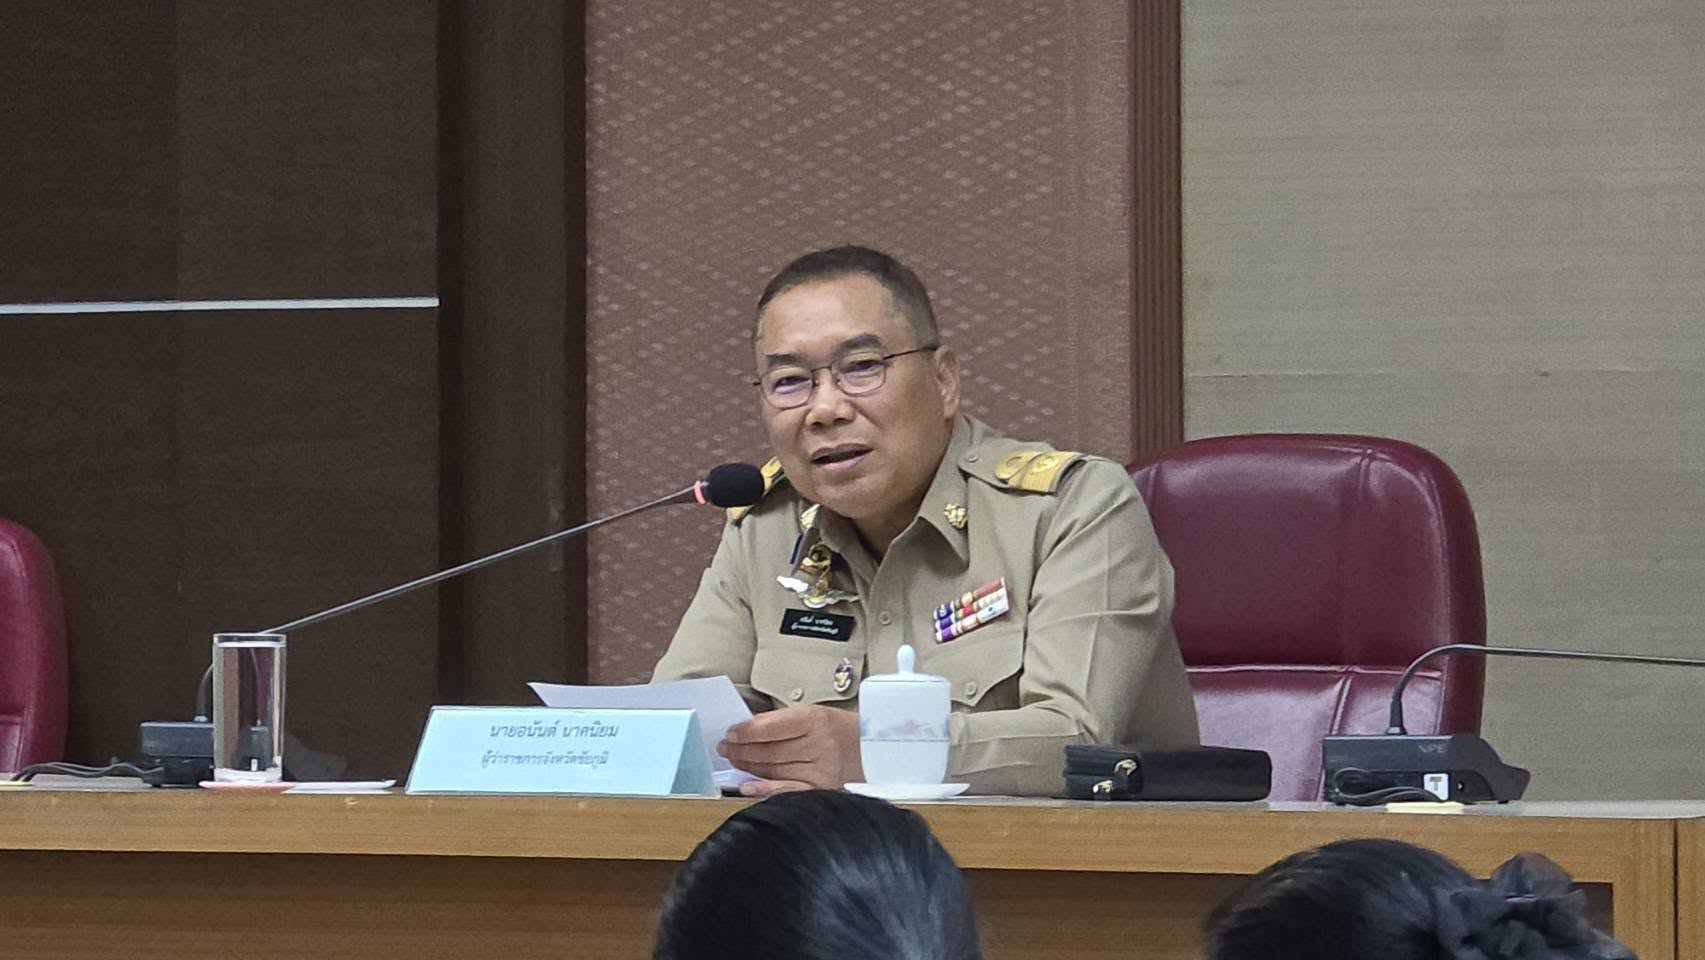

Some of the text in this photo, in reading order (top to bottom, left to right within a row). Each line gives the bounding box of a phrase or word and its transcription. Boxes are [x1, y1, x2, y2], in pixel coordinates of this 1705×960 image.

[489, 719, 620, 738] นายอนันต์ นาคนิยม
